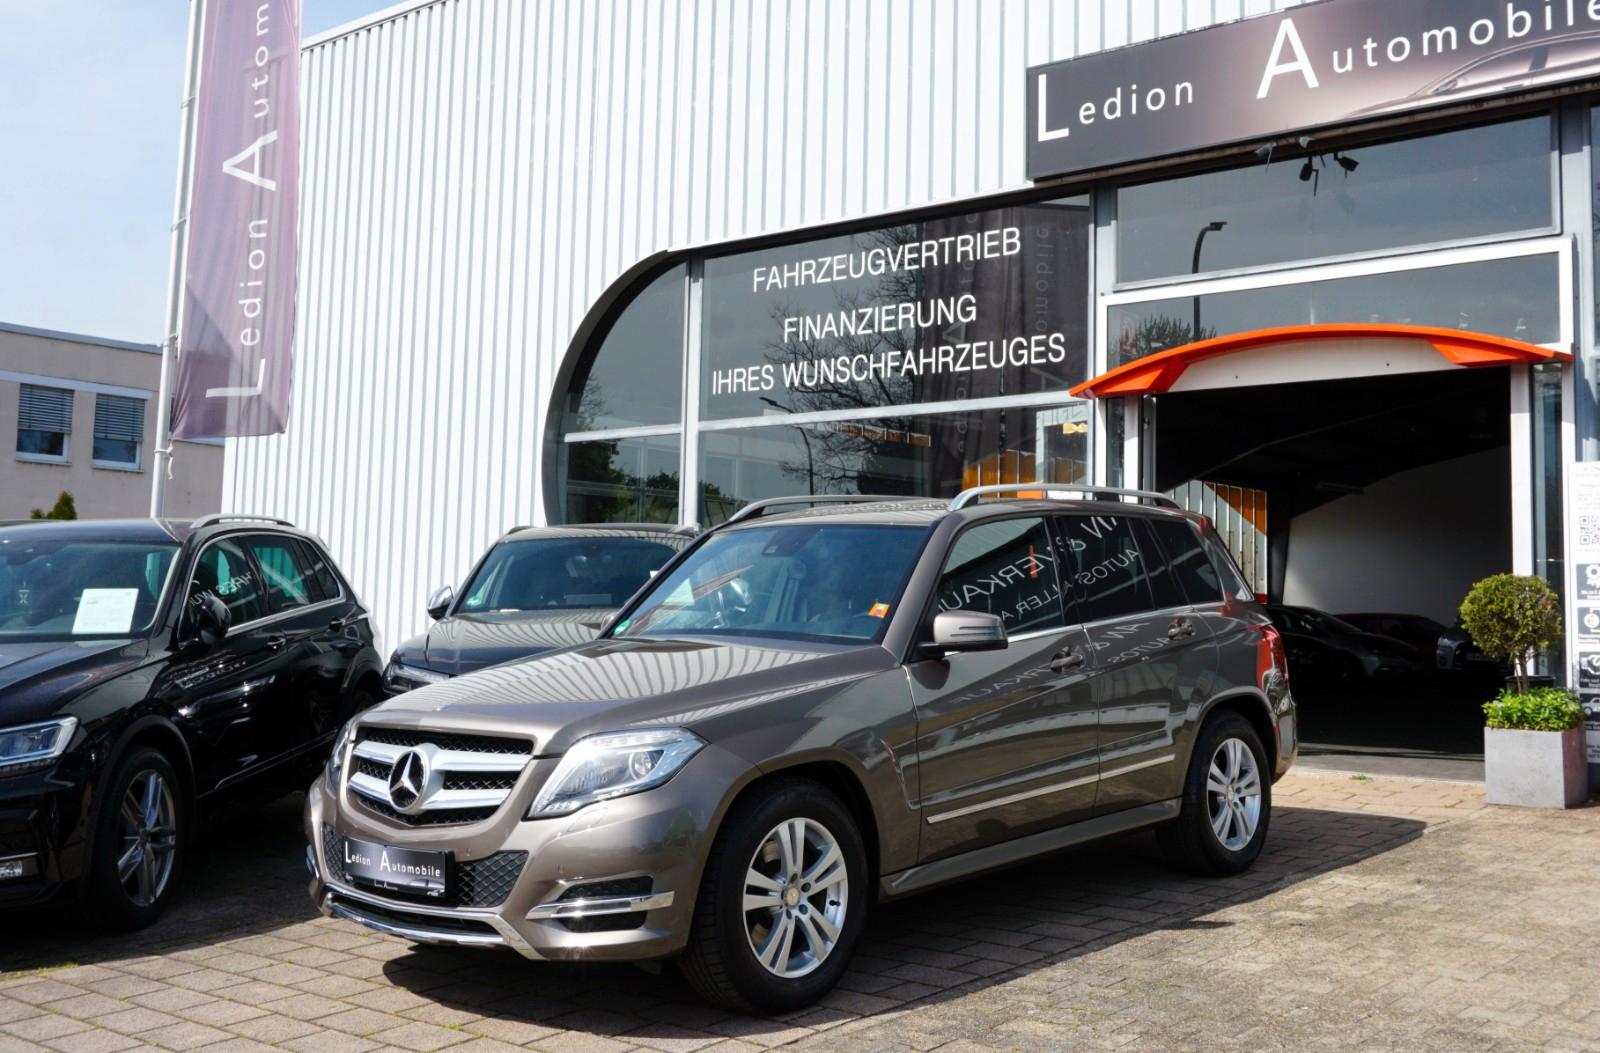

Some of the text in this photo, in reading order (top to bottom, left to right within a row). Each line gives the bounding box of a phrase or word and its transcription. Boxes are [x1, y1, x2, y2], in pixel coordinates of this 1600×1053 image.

[1037, 0, 1600, 142] Ledion Automobile
[753, 226, 1021, 293] FAHRZEUGVERTRIEB
[205, 218, 268, 398] Ledion
[783, 294, 977, 343] FINANZIERUNG
[712, 333, 1066, 395] IHRES WUNSCHFAHRZEUGES
[345, 841, 441, 877] Ledion Automobile
